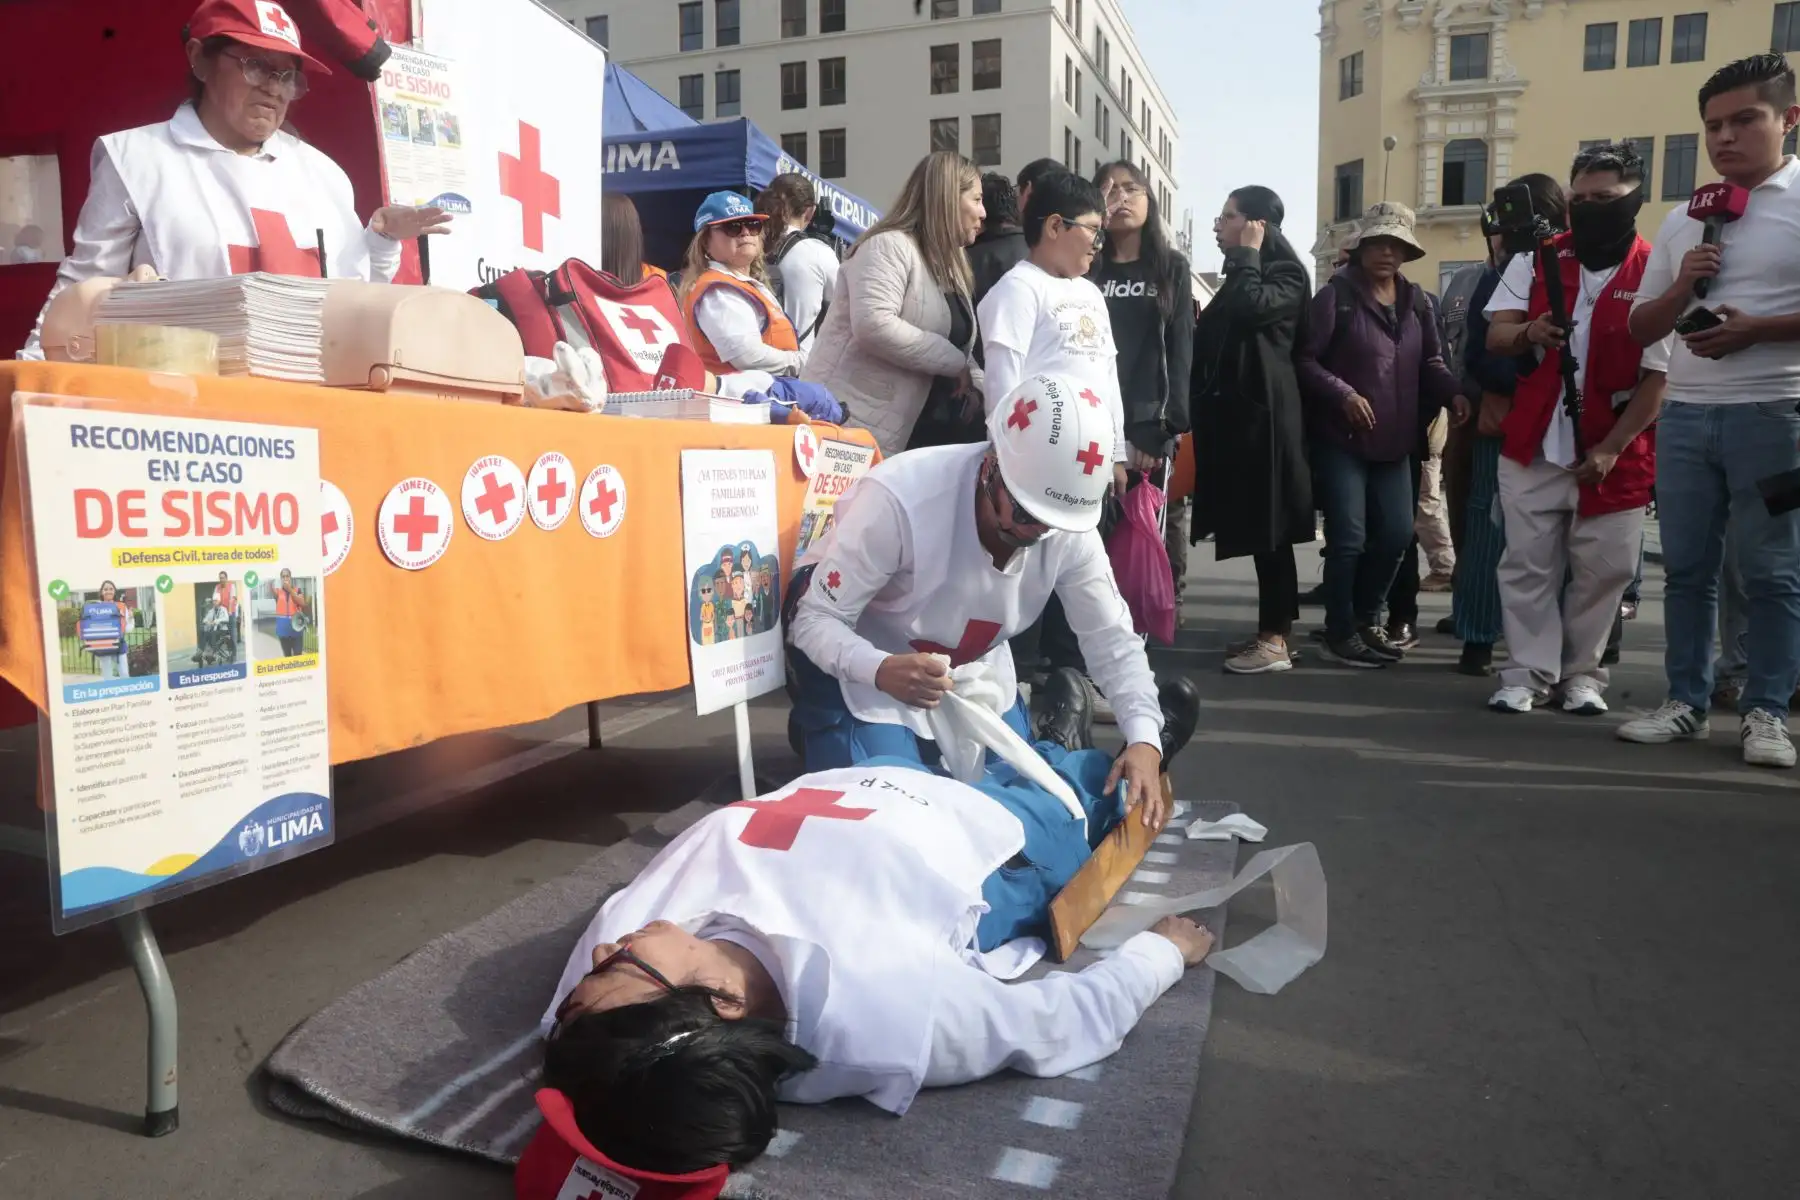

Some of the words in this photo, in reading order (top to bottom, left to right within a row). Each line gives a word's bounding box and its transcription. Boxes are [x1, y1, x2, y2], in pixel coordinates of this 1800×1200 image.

[391, 52, 448, 72] COMENDACIONES
[402, 64, 412, 72] EN
[412, 66, 430, 78] CASO
[384, 70, 404, 90] DE
[406, 75, 451, 99] SISMO
[600, 140, 681, 174] IMA
[446, 201, 469, 212] LIMA
[725, 206, 750, 216] LIMA
[478, 258, 509, 284] Cru
[1102, 280, 1158, 297] didas
[1613, 289, 1622, 299] LA
[1045, 382, 1060, 400] Roja
[1049, 402, 1064, 445] Peruana
[70, 424, 295, 460] RECOMENDACIONES
[824, 447, 868, 464] RECOMENDACIONES
[148, 459, 180, 482] EN
[186, 462, 242, 484] CASO
[712, 468, 738, 482] TIENES
[749, 468, 766, 480] PLAN
[711, 487, 746, 500] FAMILIAR
[747, 487, 756, 498] DE
[814, 473, 830, 494] DE
[829, 475, 858, 496] SISM
[1045, 487, 1062, 500] Cruz
[1063, 492, 1079, 505] Roja
[74, 488, 148, 538] DE
[162, 490, 300, 537] SISMO
[118, 552, 170, 566] ¡Defensa
[173, 550, 200, 562] Civil,
[202, 550, 228, 561] tarea
[231, 548, 242, 560] de
[245, 548, 274, 560] todos!
[180, 675, 192, 684] En
[200, 669, 239, 682] respuesta
[257, 665, 266, 674] En
[268, 664, 274, 672] la
[72, 689, 86, 700] En
[88, 688, 98, 698] la
[100, 681, 154, 698] preparación
[72, 708, 100, 717] Elabora
[880, 780, 929, 806] Cruz
[267, 806, 314, 825] MUNICIPALIDAD
[268, 812, 324, 848] LIMA
